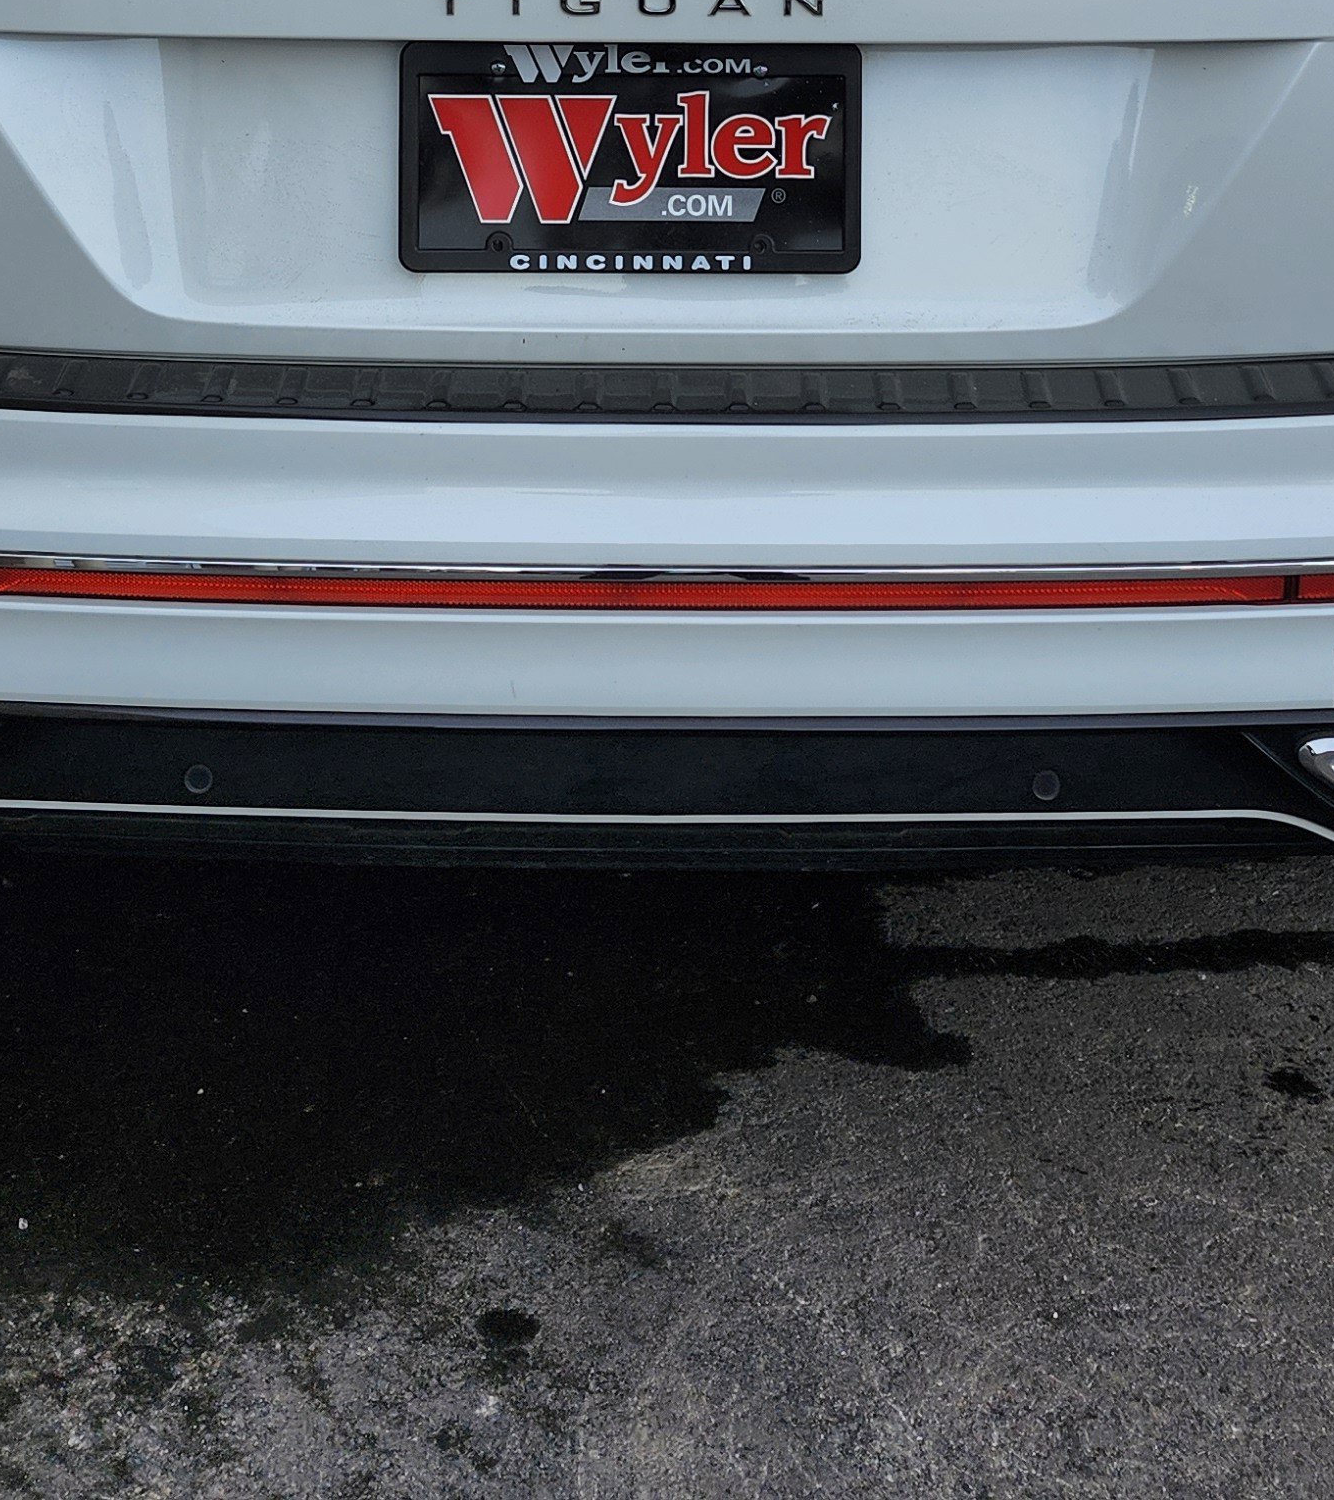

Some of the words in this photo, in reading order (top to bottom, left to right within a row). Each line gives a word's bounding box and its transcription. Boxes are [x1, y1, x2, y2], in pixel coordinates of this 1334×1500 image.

[428, 90, 831, 225] Wyler
[661, 193, 734, 217] .COM
[509, 253, 753, 272] CINCINNATI
